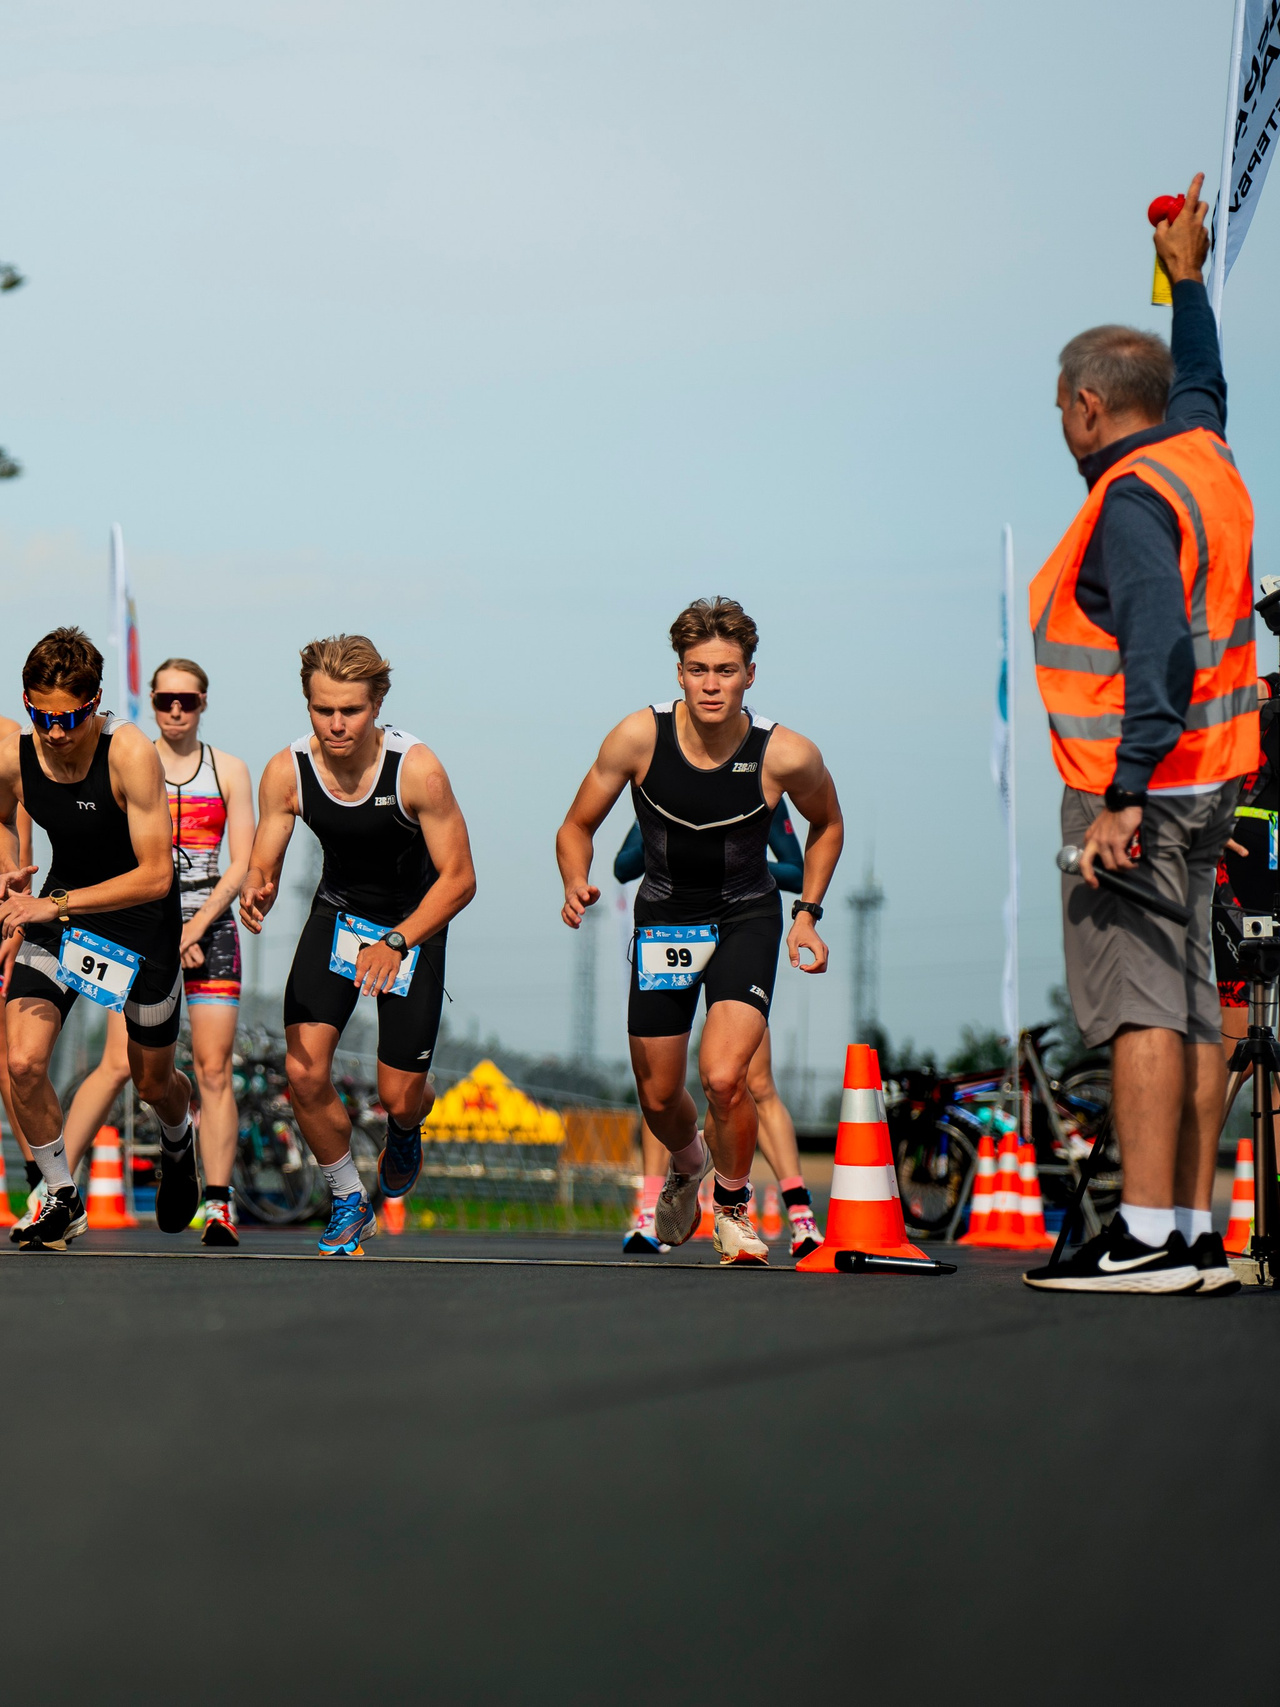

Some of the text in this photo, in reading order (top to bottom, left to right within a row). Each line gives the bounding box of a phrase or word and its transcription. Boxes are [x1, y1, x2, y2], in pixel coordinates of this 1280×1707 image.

[76, 801, 97, 811] TYR
[665, 947, 693, 968] 99
[81, 955, 109, 982] 91
